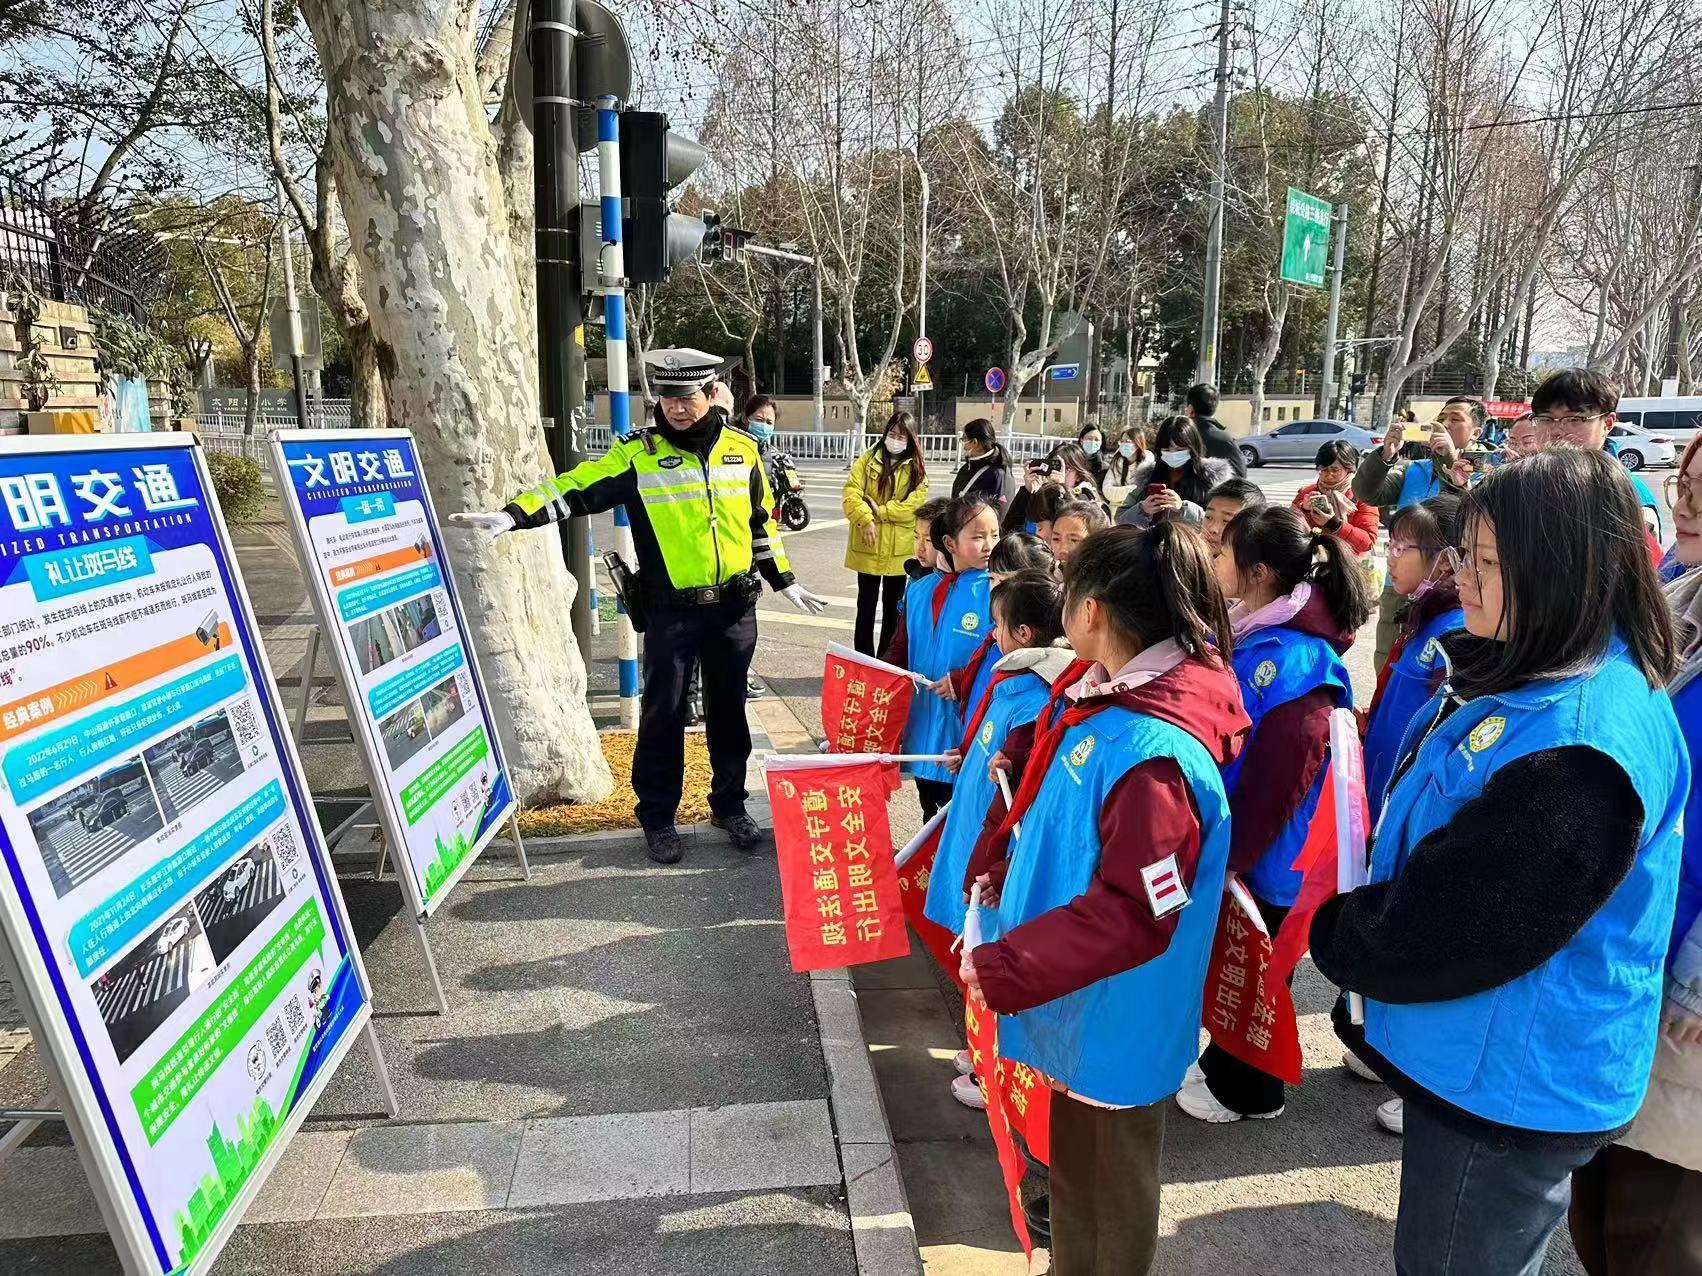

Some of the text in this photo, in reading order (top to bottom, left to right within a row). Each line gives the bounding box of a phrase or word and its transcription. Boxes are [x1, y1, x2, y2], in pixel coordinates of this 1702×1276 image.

[212, 398, 288, 407] 太阳小学
[288, 449, 414, 489] 文明交通
[307, 480, 412, 501] CIVILIZED TRANSPORTATION
[58, 513, 192, 545] TRANSPORTATION
[45, 546, 137, 587] 礼让斑马线
[3, 695, 55, 730] 经典案例
